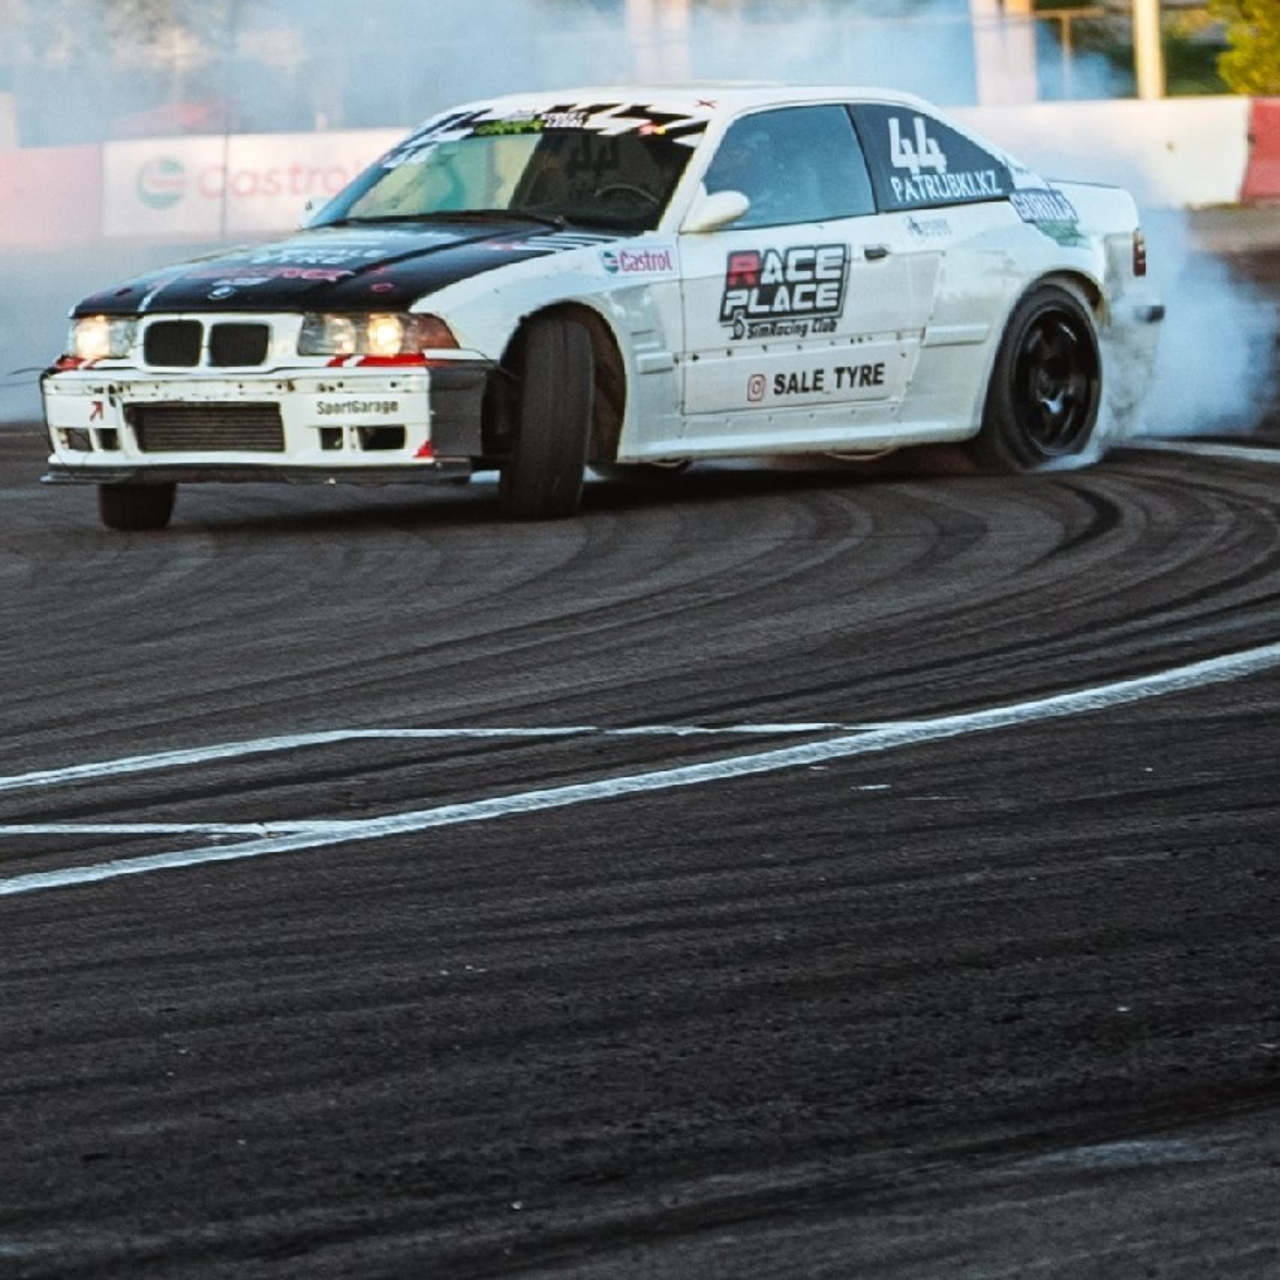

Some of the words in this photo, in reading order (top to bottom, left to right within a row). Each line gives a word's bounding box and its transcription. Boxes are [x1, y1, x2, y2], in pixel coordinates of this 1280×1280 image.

[888, 117, 948, 175] 44
[620, 249, 673, 272] Castrol
[727, 246, 845, 286] RACE
[722, 281, 840, 317] PLACE
[811, 317, 838, 334] Club
[317, 400, 399, 415] SportGarage
